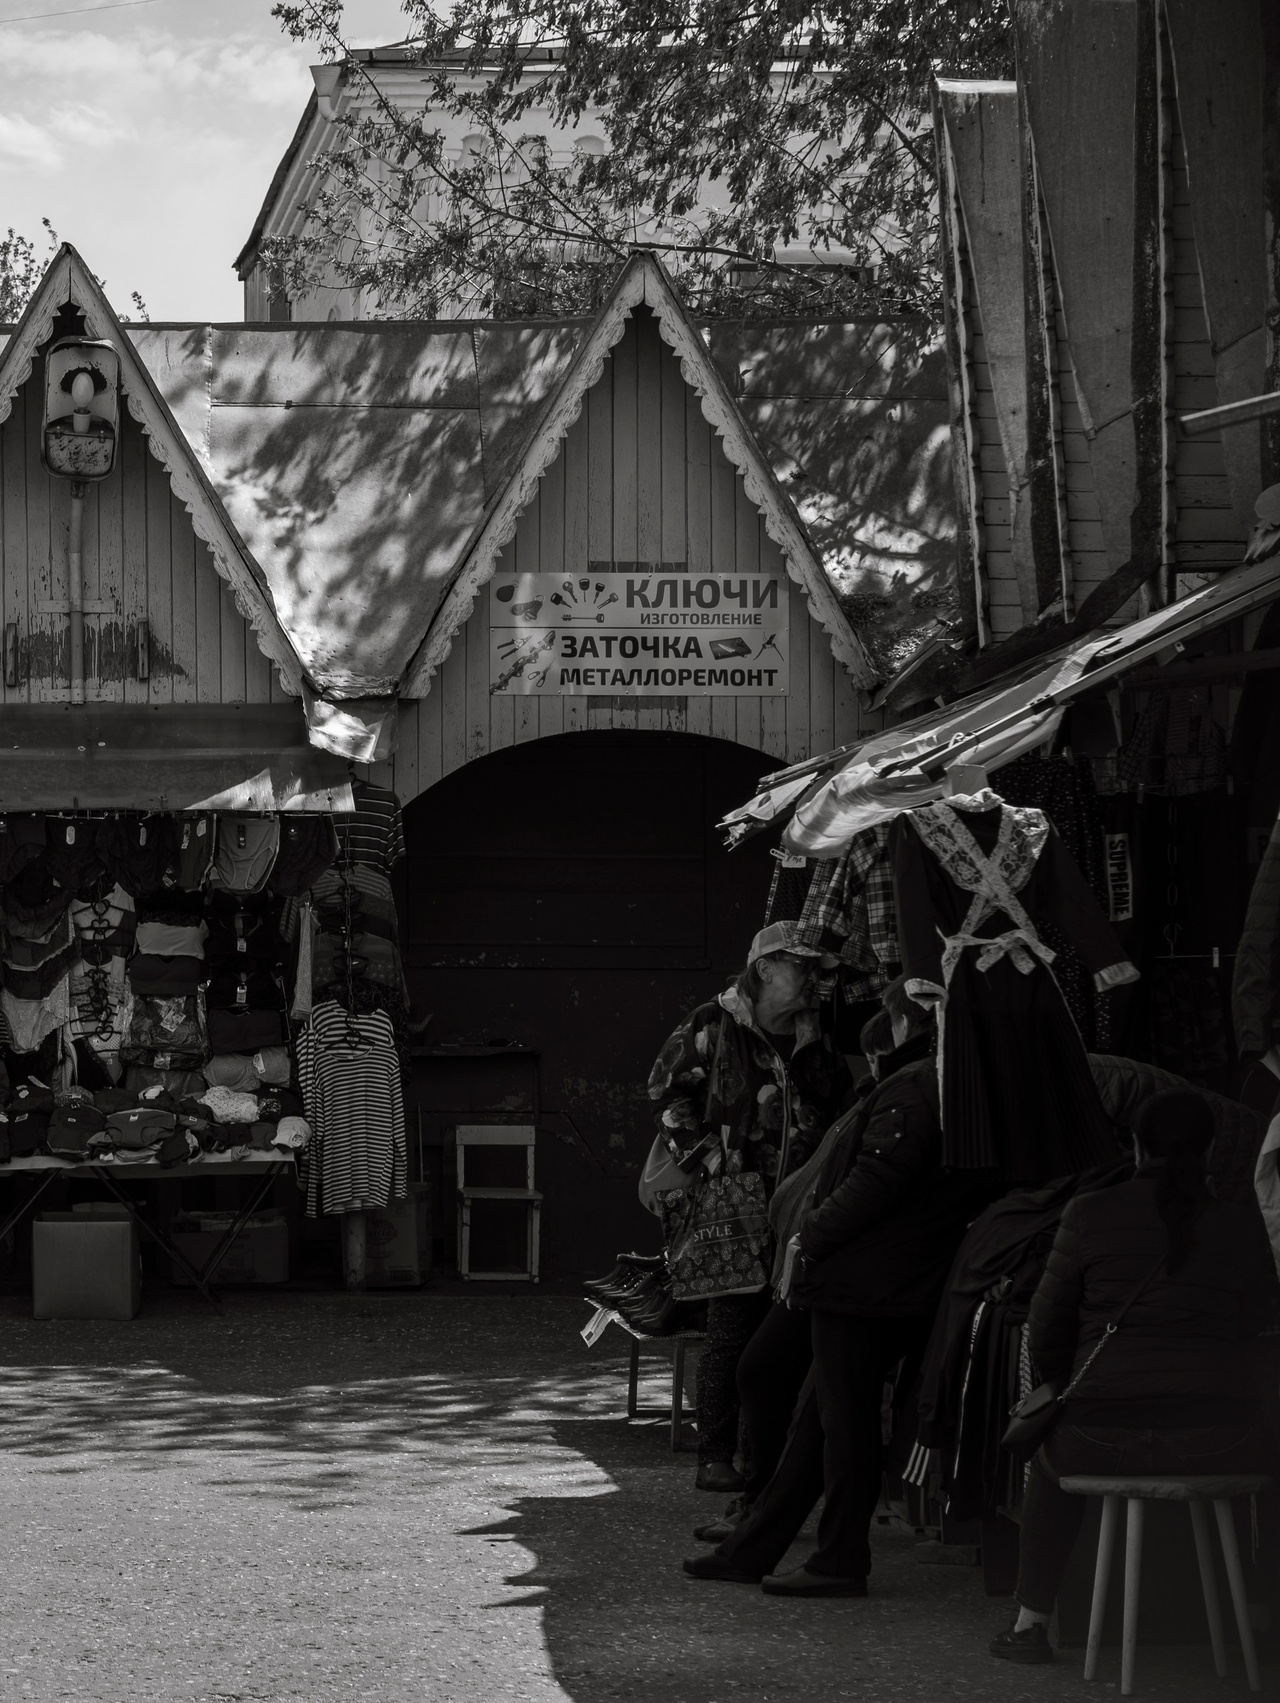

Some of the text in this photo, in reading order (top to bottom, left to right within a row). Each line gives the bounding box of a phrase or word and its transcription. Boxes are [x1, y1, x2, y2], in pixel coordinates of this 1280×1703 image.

[626, 579, 778, 609] КЛЮЧИ
[640, 613, 762, 625] ИЗГОТОВЛЕНИЕ
[560, 635, 703, 659] ЗАТОЧКА
[560, 668, 778, 686] МЕТАЛЛОРЕМОНТ
[1109, 839, 1130, 915] SUPREME
[693, 1224, 732, 1242] STYLE
